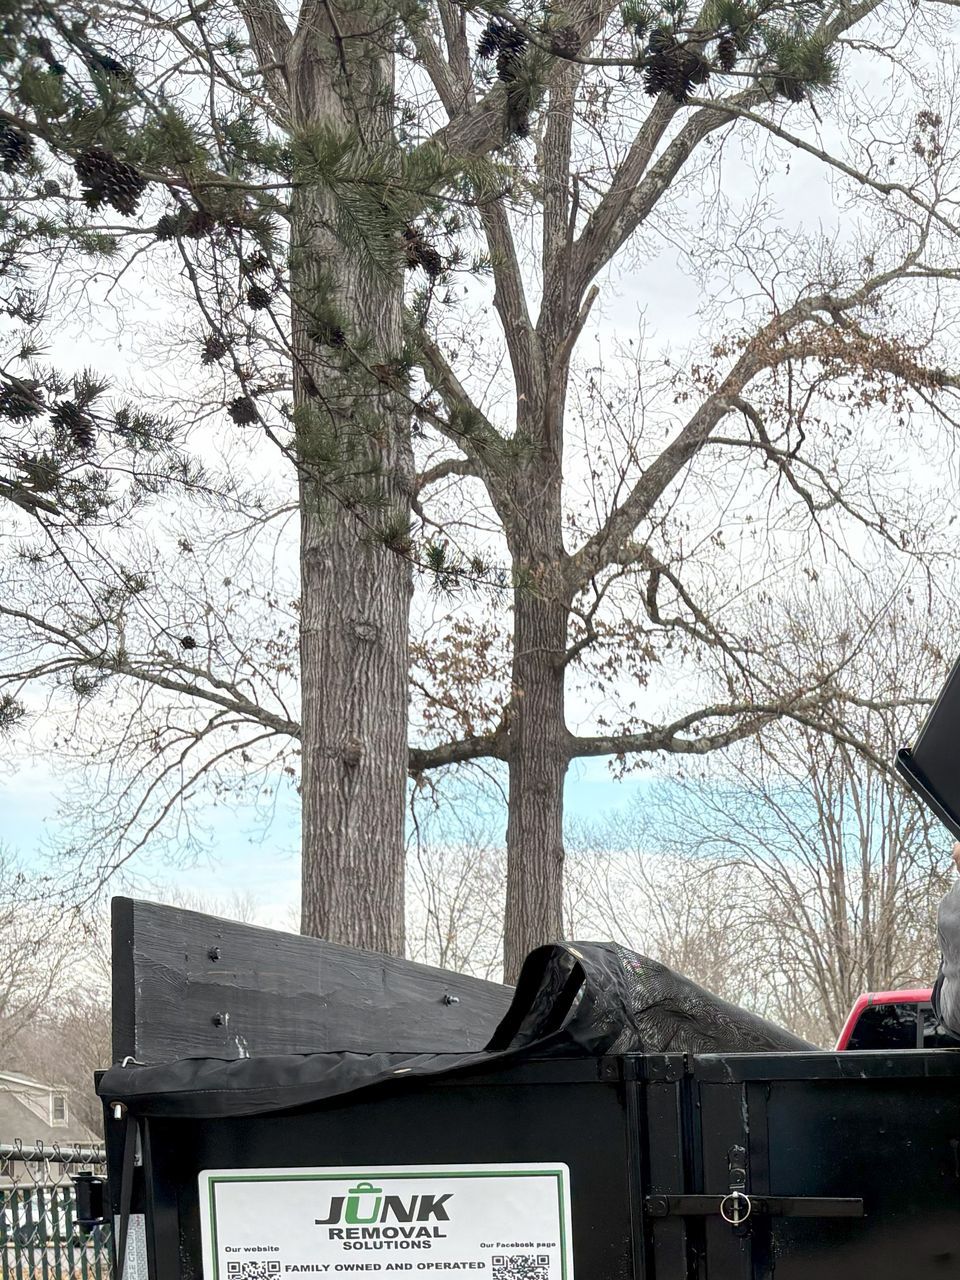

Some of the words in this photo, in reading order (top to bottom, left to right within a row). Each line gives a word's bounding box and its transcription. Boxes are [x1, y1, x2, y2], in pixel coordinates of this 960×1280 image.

[315, 1193, 454, 1225] JUNK
[328, 1226, 447, 1240] REMOVAL
[343, 1240, 432, 1250] SOLUTIONS
[285, 1264, 330, 1272] FAMILY
[334, 1263, 382, 1271] OWNED
[416, 1261, 486, 1270] OPERATED
